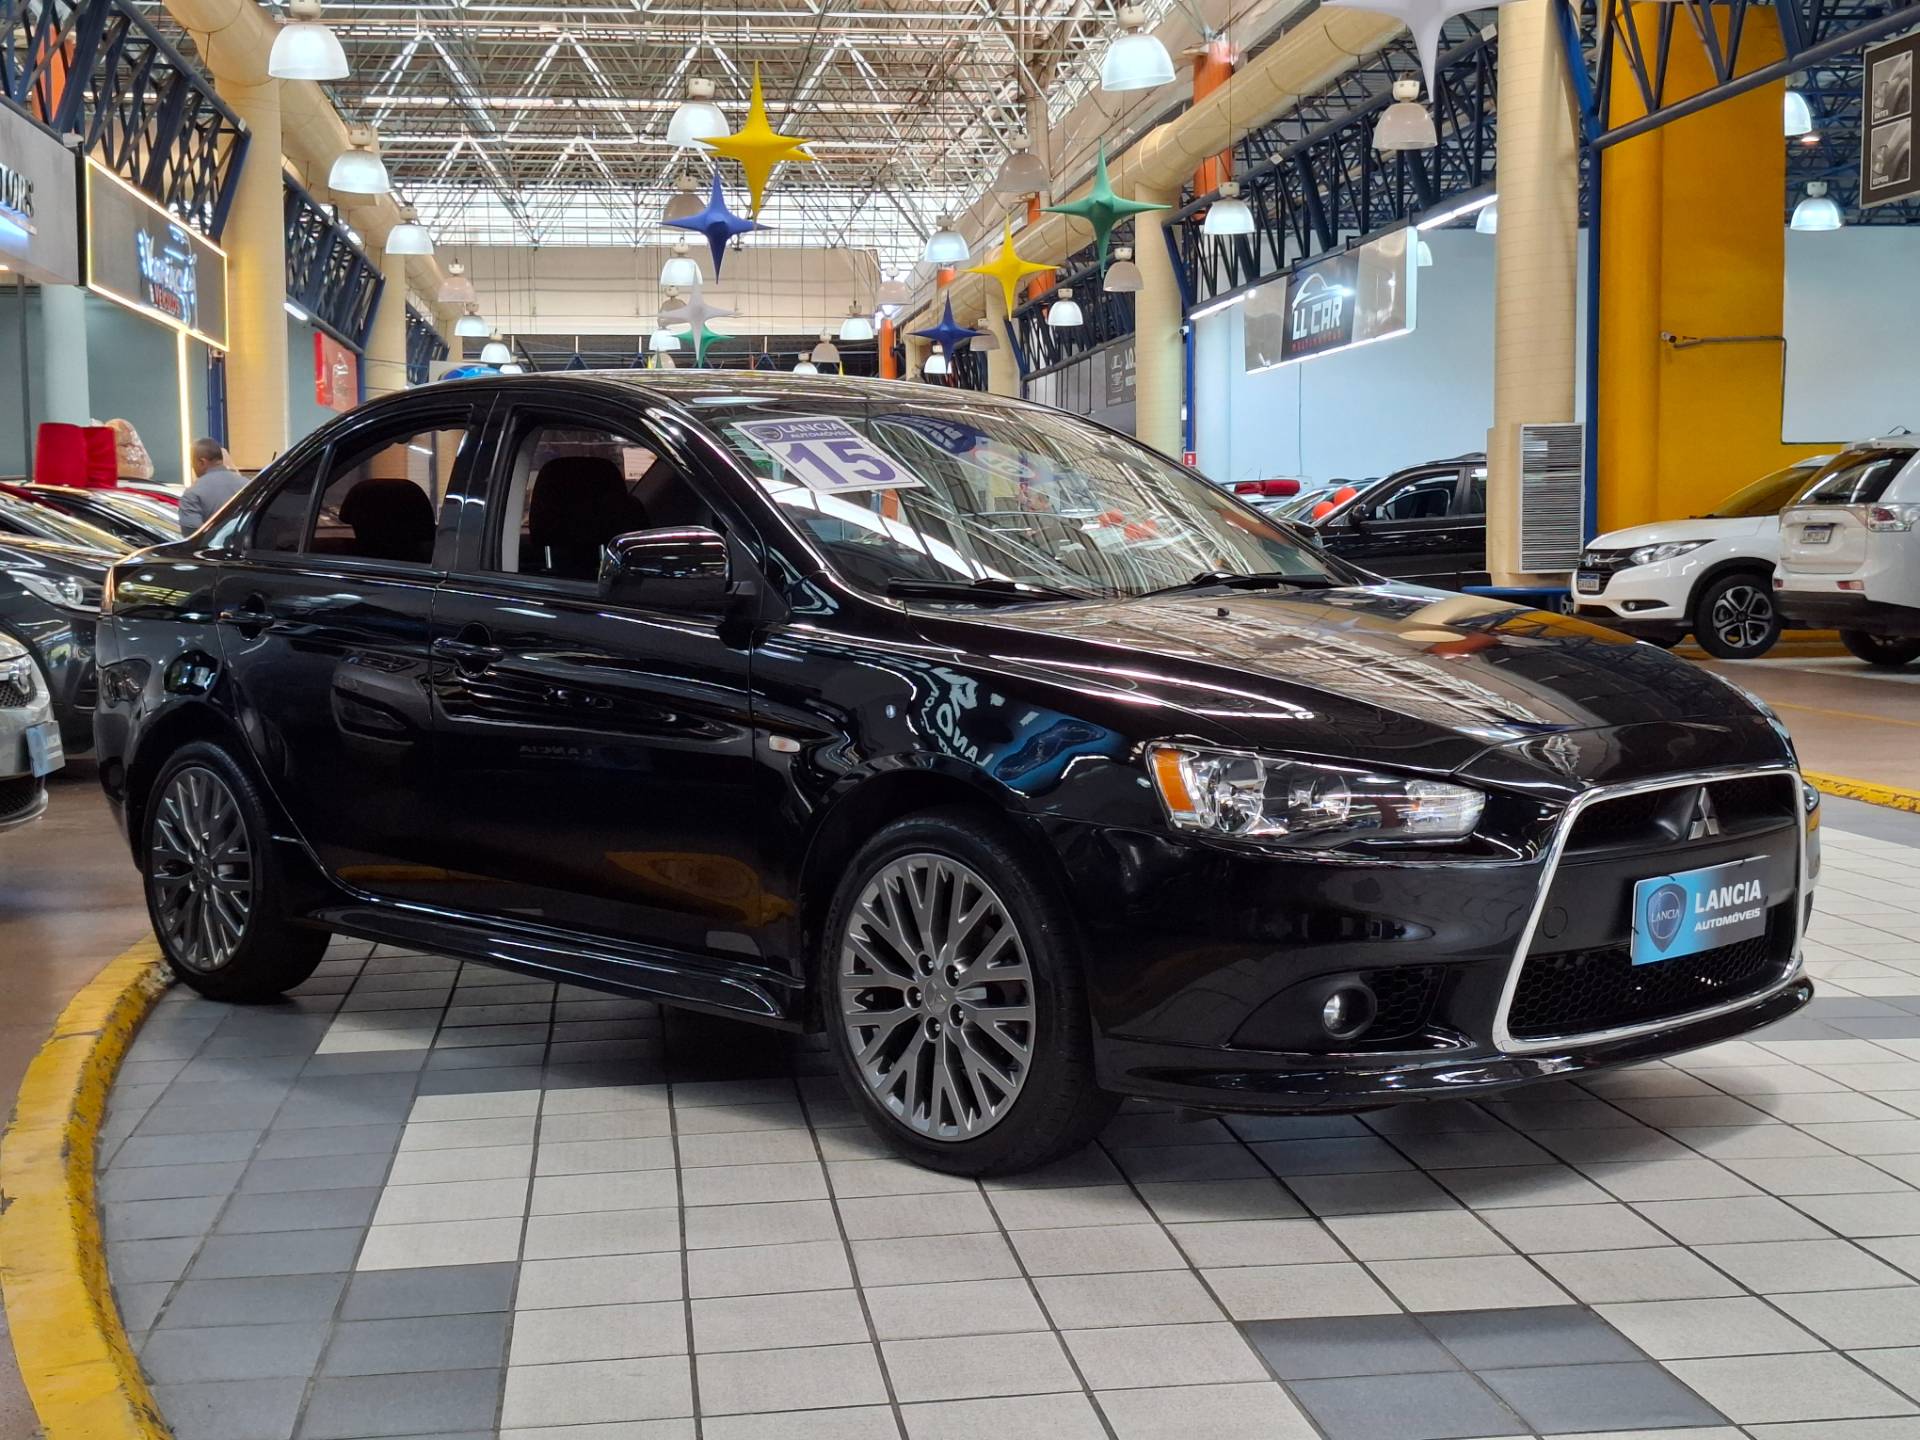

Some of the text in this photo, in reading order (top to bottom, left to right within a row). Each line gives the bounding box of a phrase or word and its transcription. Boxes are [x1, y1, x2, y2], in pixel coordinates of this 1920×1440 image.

[1293, 296, 1343, 340] LL CAR
[779, 422, 845, 433] LANCIA
[785, 441, 897, 484] 15
[1695, 879, 1762, 914] LANCIA
[1651, 909, 1681, 922] LANCIA
[1694, 907, 1761, 932] AUTOMÓVEIS
